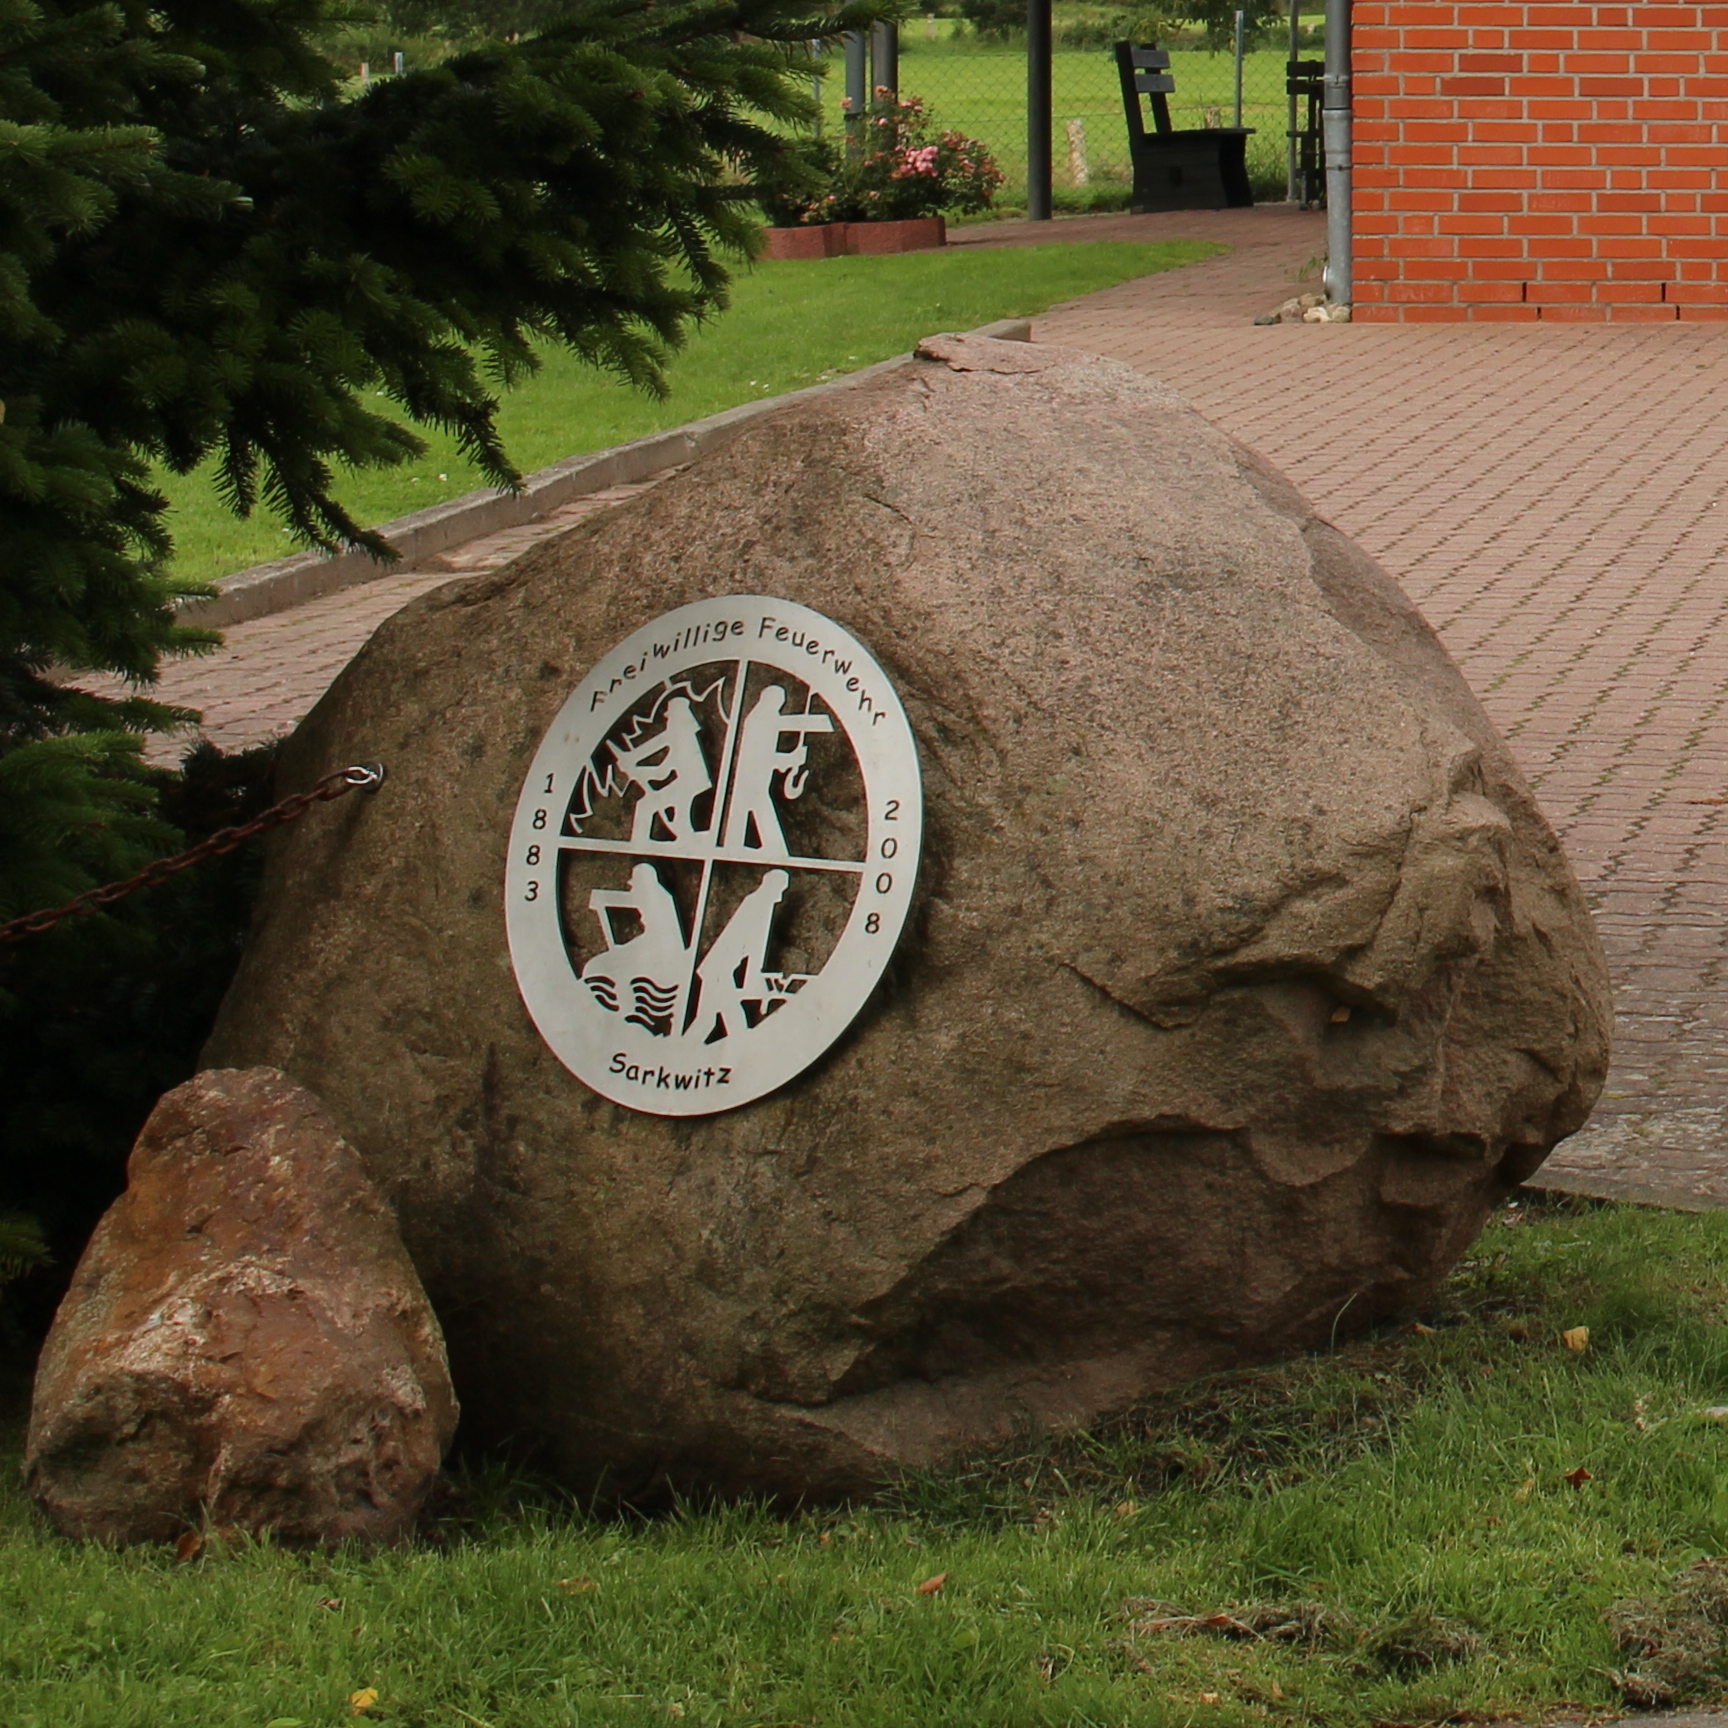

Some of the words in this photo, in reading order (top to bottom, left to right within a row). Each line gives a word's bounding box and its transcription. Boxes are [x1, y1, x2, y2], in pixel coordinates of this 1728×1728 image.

[590, 620, 745, 712] Freiwillige
[758, 617, 887, 727] Feuerwehr
[523, 772, 555, 903] 1883
[864, 799, 901, 935] 2008
[608, 1052, 732, 1091] Sarkwitz
